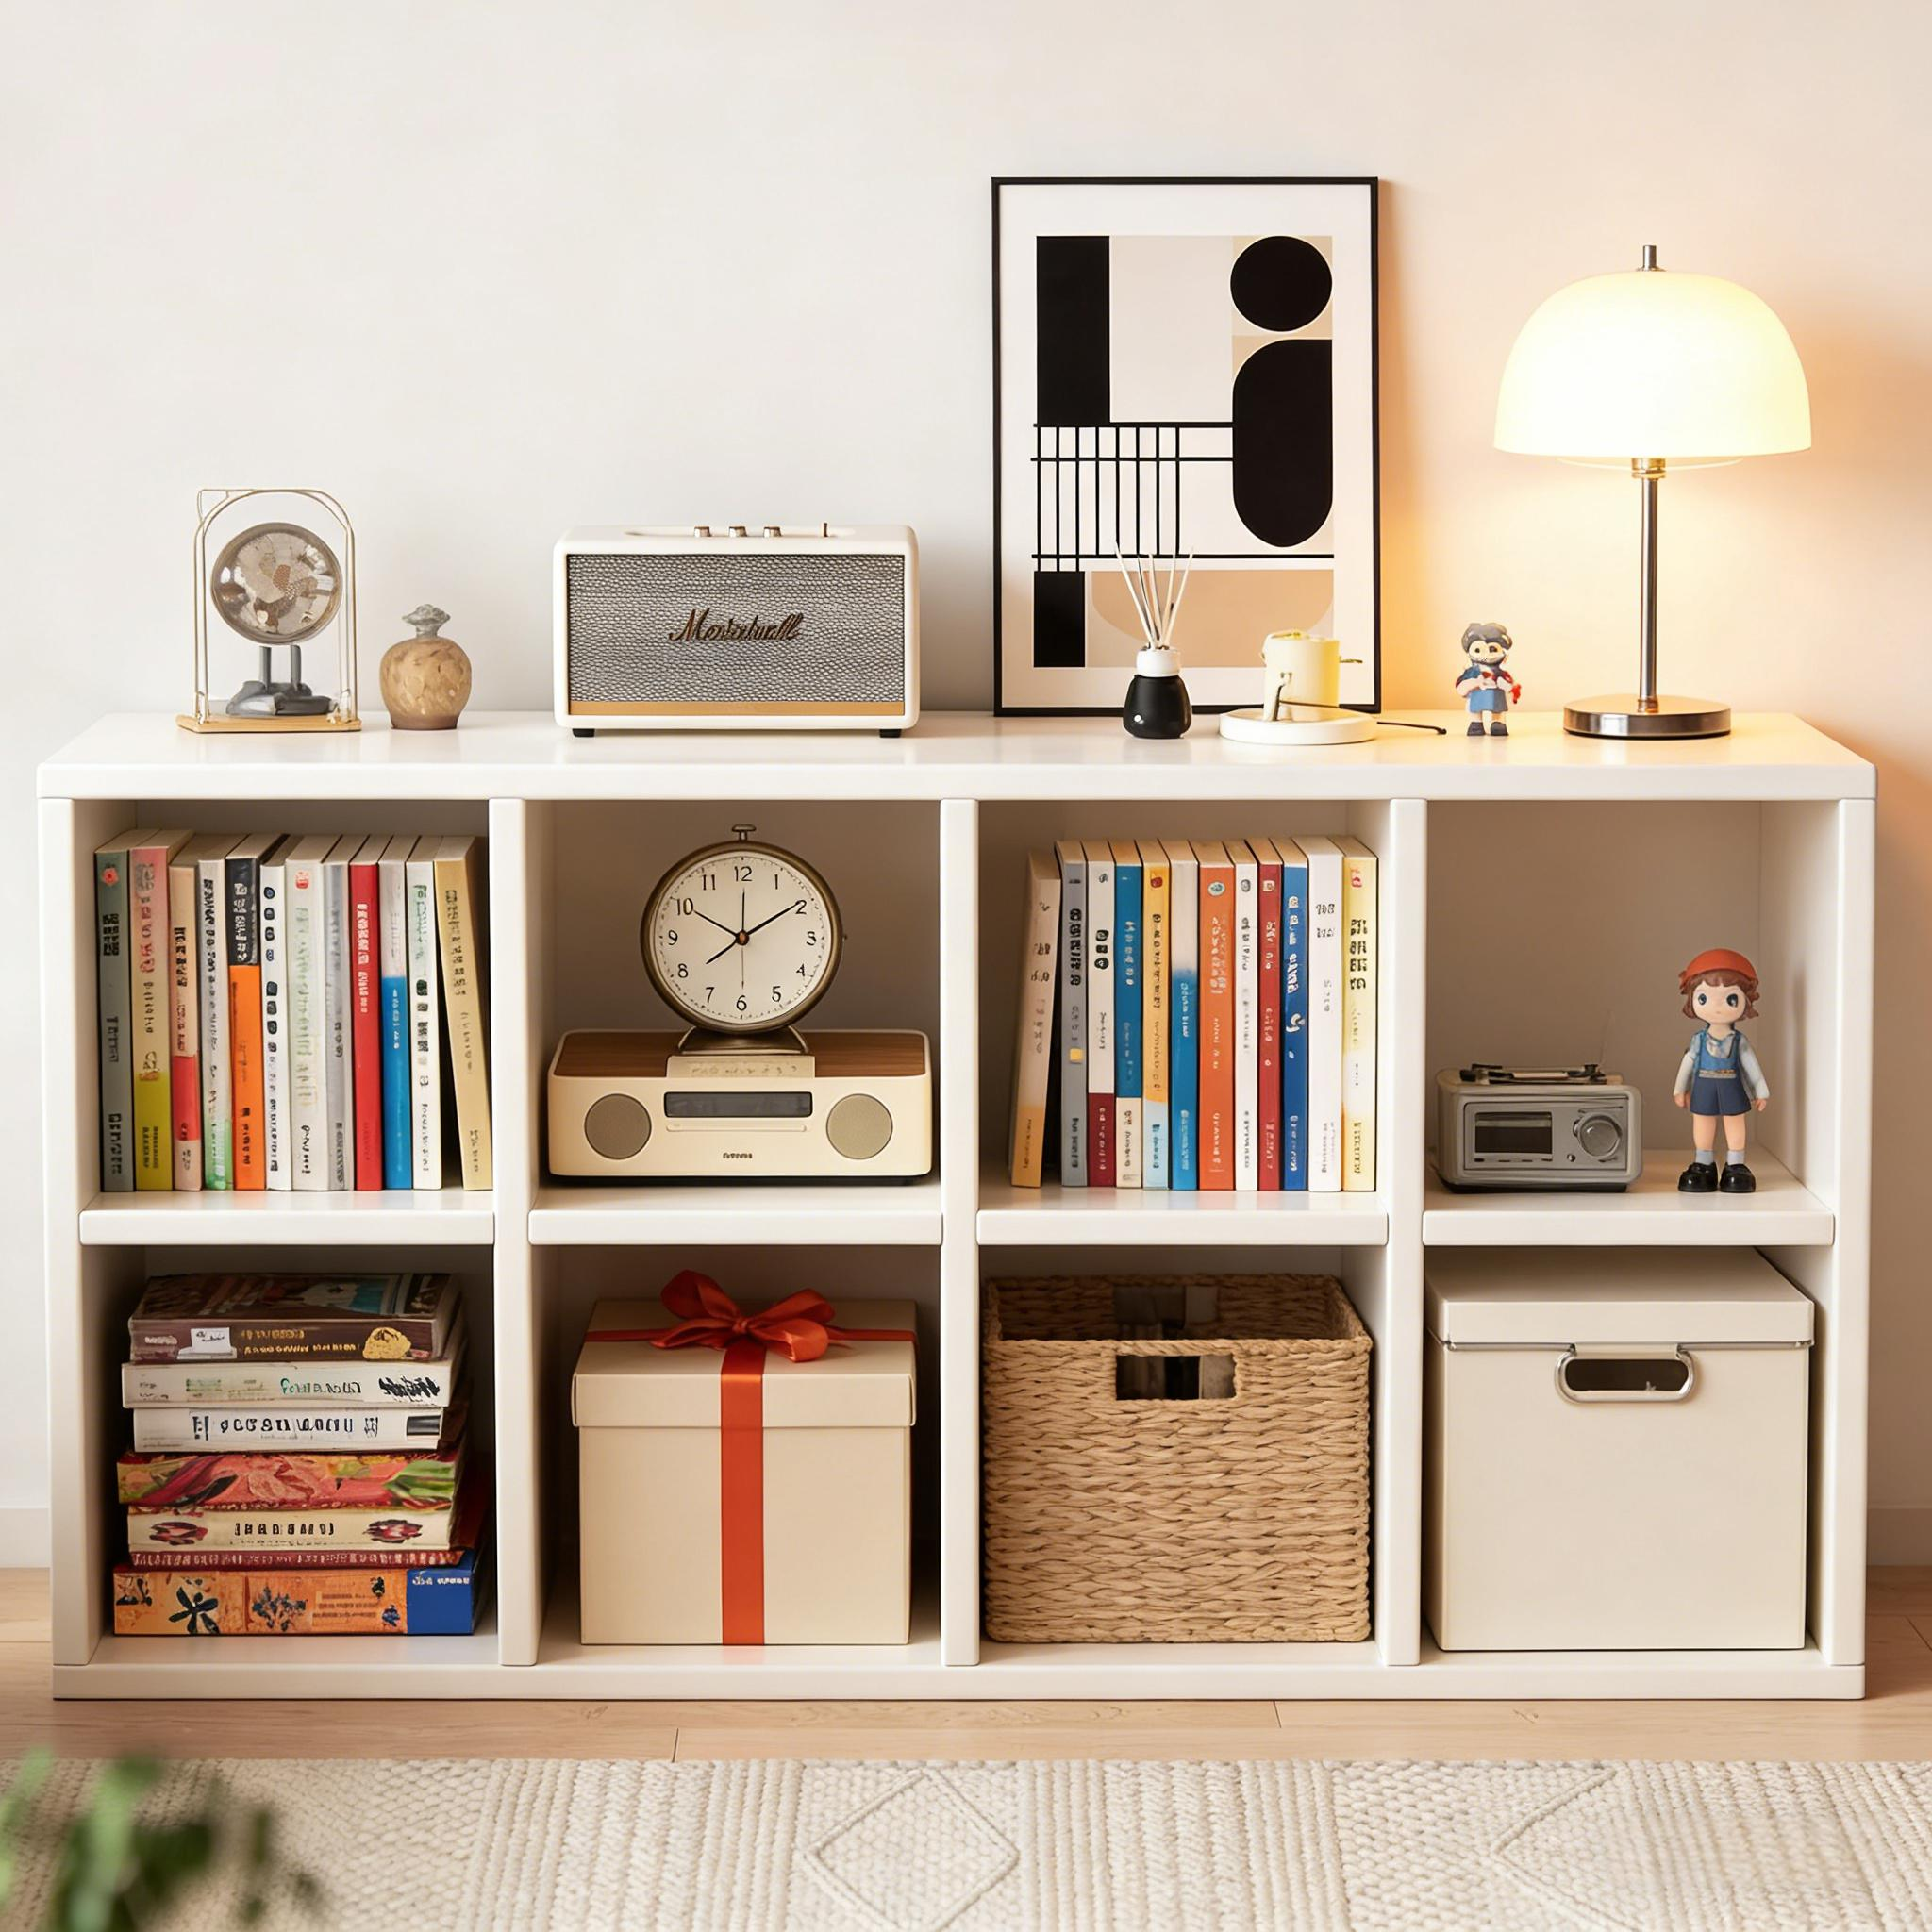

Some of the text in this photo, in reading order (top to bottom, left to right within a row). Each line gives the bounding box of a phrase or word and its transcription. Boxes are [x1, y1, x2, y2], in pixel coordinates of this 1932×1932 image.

[734, 866, 753, 882] 12
[774, 874, 778, 890] 1
[702, 874, 716, 891] 11
[676, 898, 694, 915] 10
[795, 899, 807, 914] 2
[668, 930, 678, 945] 9
[677, 963, 689, 978] 8
[705, 987, 715, 1004] 7
[772, 986, 781, 1002] 5
[736, 995, 747, 1011] 6
